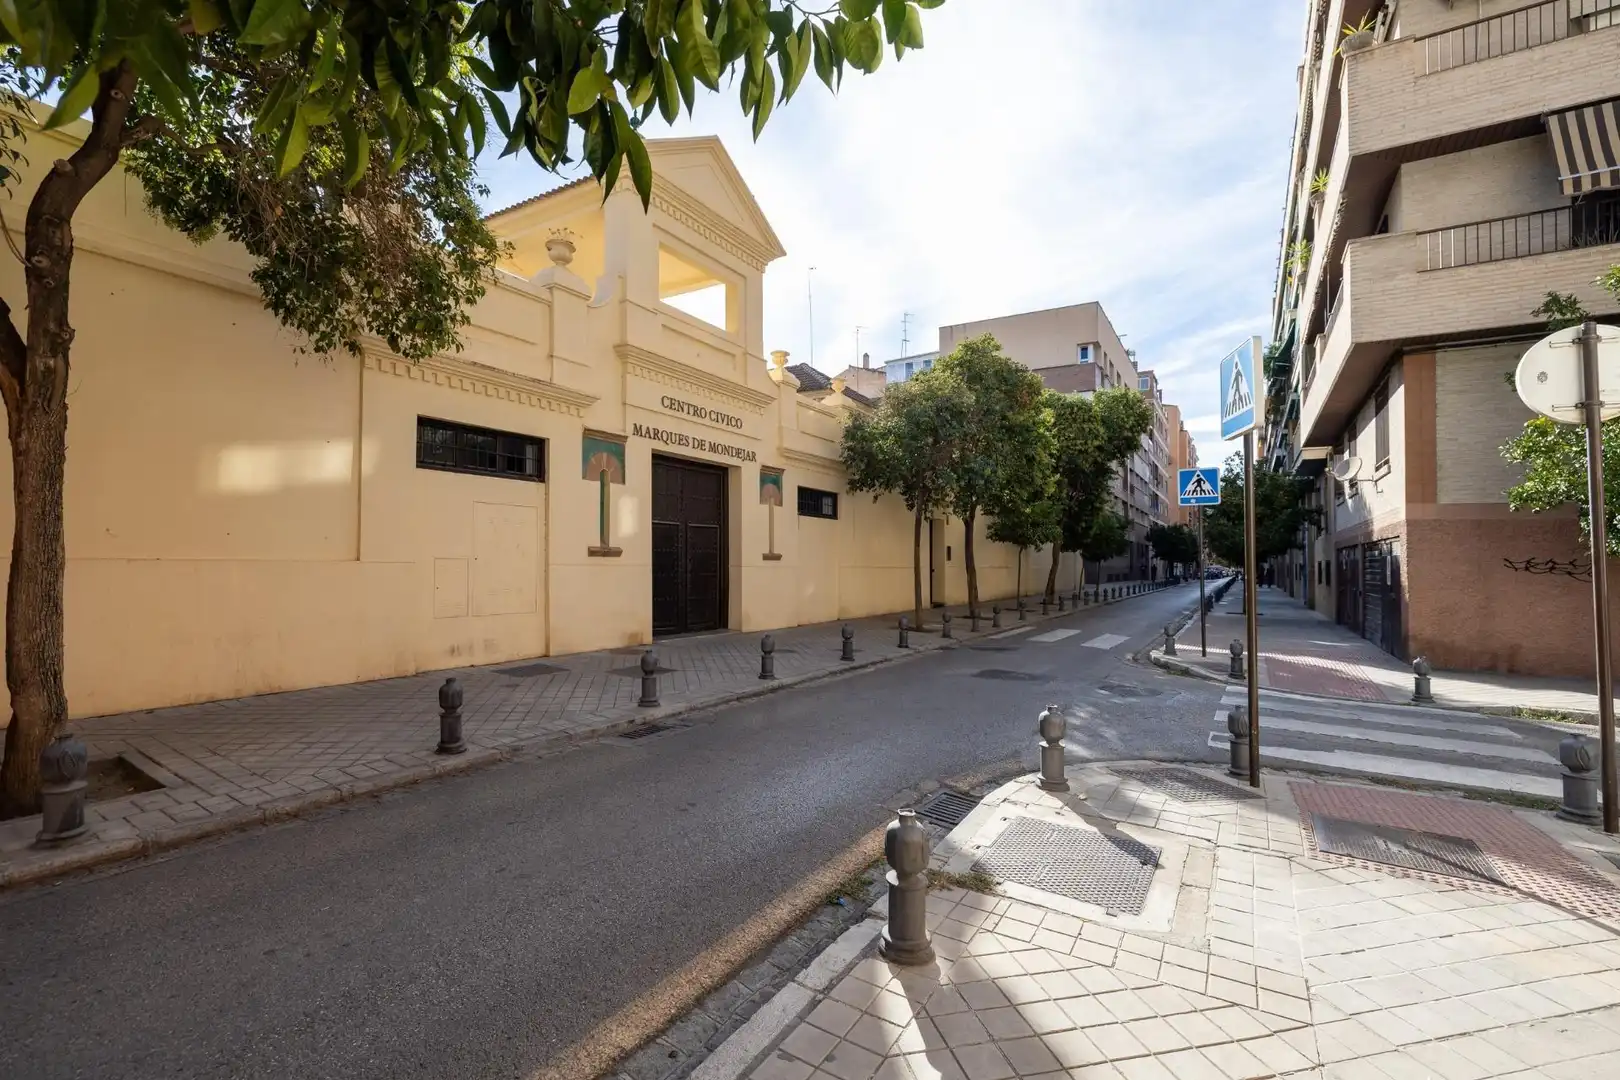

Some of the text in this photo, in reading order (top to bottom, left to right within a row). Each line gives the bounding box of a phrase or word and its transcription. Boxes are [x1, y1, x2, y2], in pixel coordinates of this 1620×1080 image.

[660, 395, 743, 430] CENTRO CIVICO
[632, 423, 757, 462] MARQUES DE MONDEJAR
